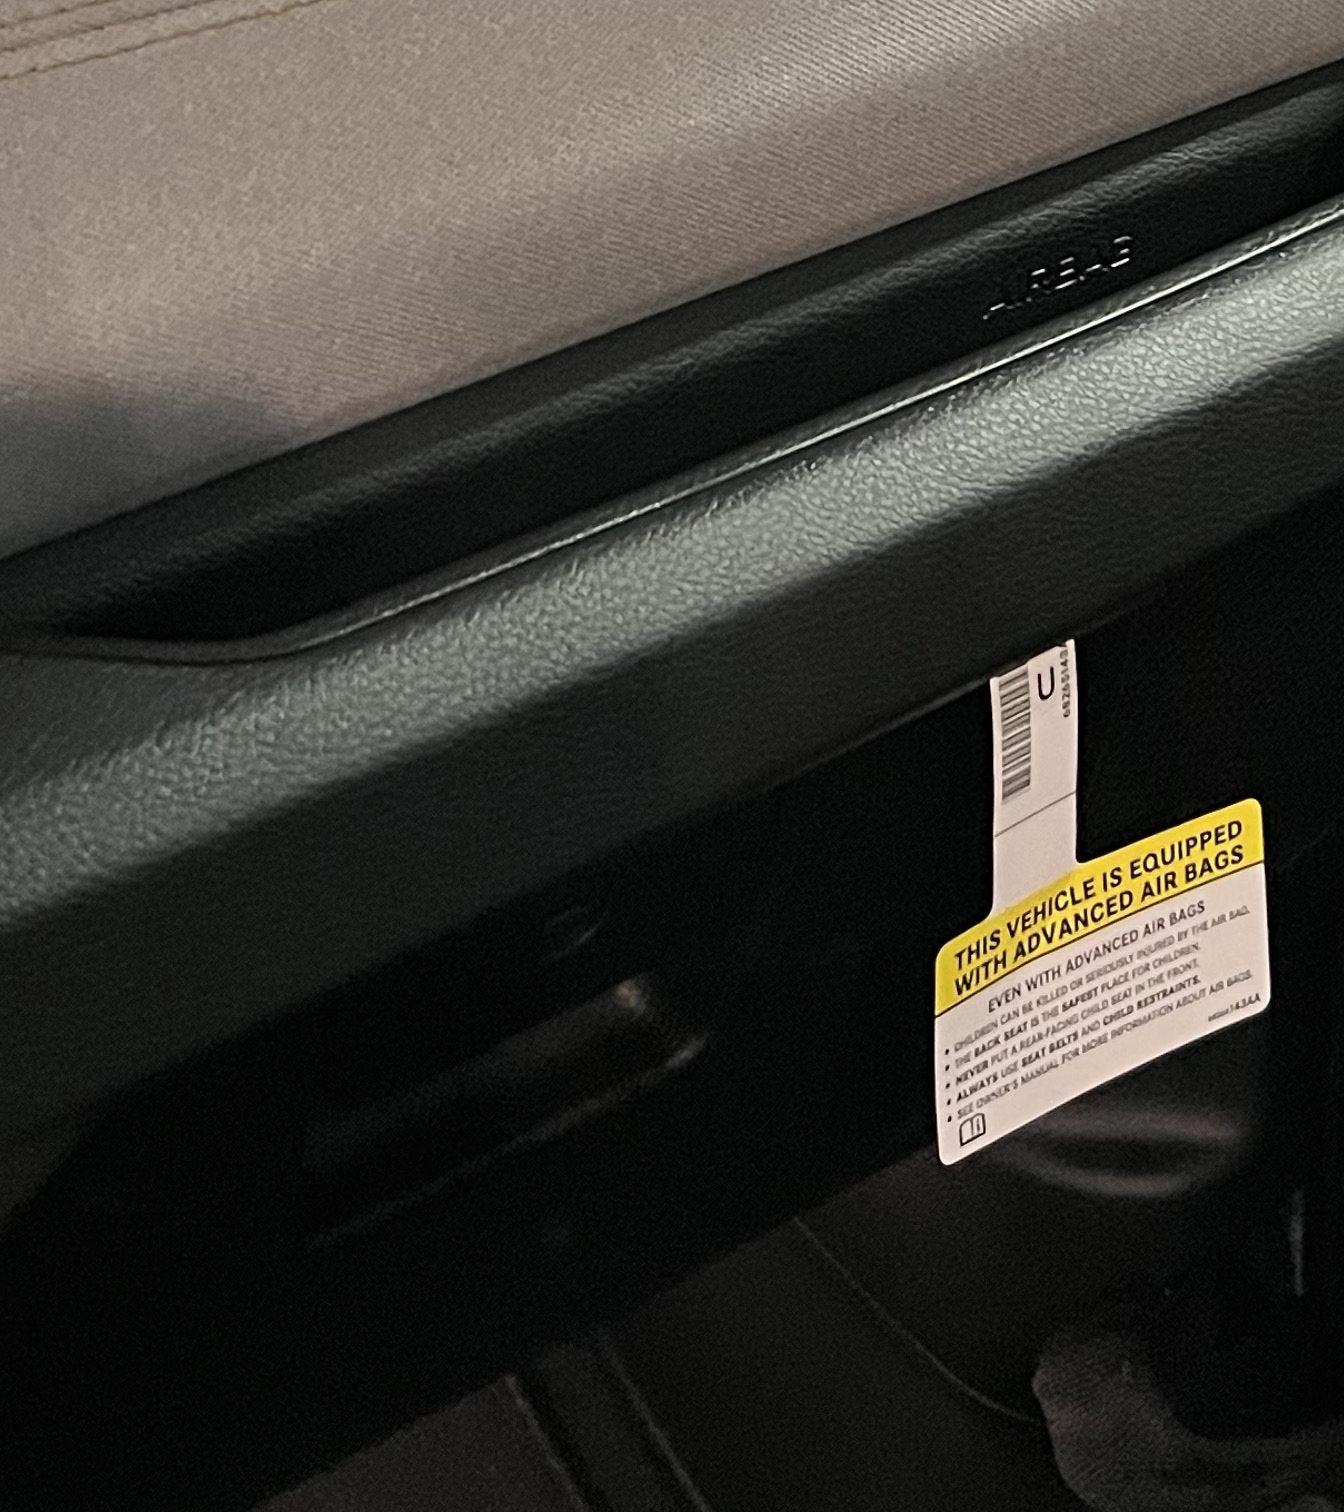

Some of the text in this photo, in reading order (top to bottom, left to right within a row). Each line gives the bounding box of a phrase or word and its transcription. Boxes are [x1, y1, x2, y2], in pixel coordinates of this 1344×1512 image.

[1037, 666, 1055, 702] U
[954, 820, 1243, 971] THIS VEHICLE IS EQUIPPED
[954, 844, 1244, 996] WITH ADVANCED AIR BAGS
[988, 898, 1205, 1013] EVEN WITH ADVANCED AIR BAGS
